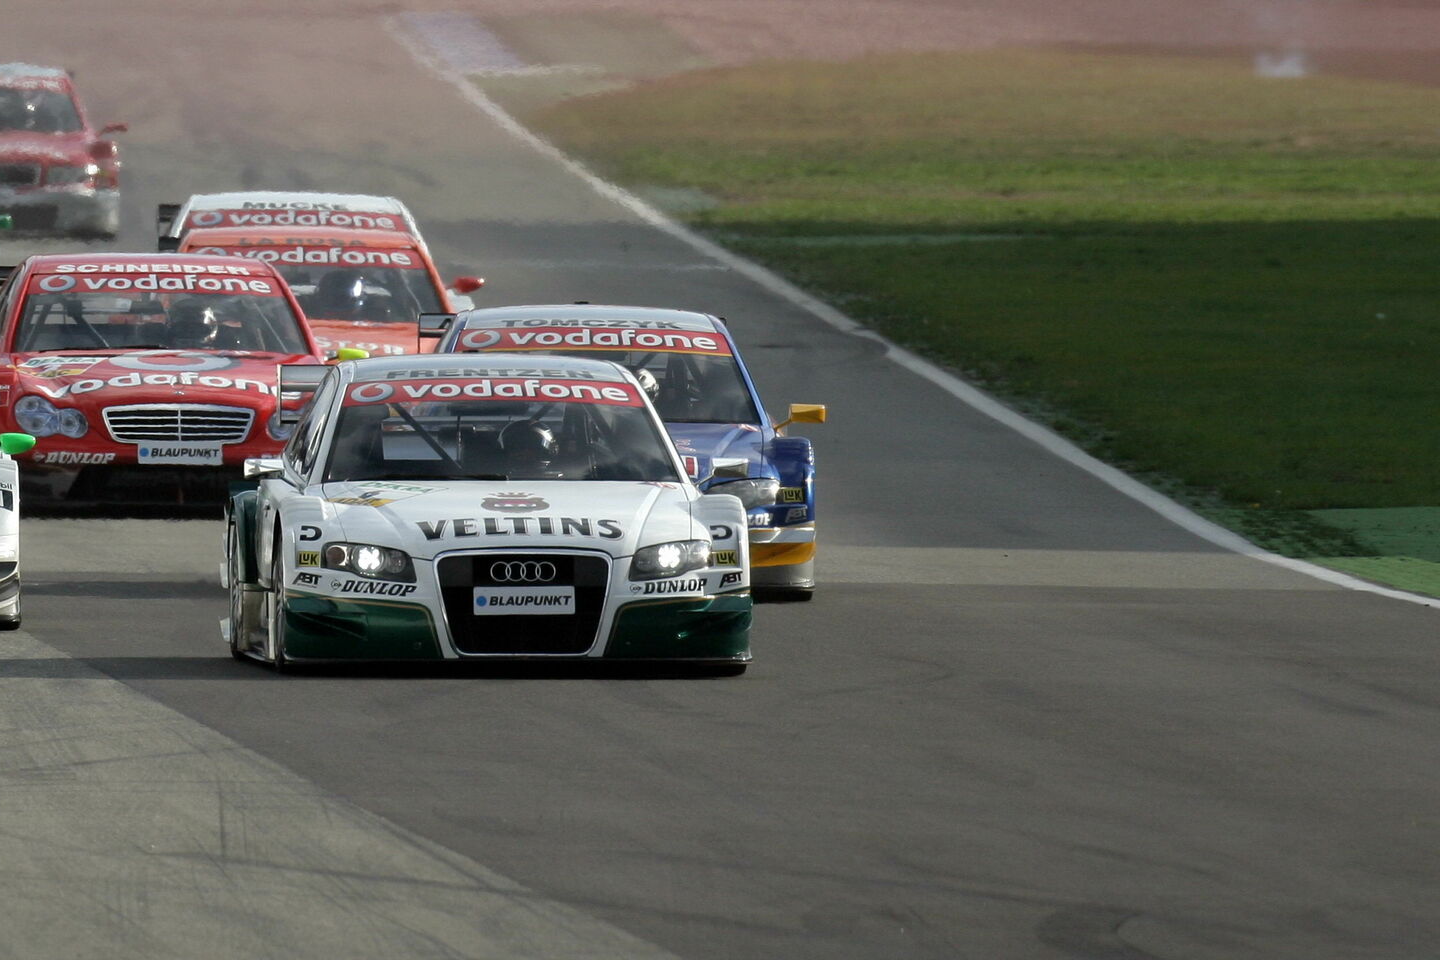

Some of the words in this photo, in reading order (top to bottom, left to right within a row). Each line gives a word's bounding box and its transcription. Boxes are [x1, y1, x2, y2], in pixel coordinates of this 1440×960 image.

[230, 211, 395, 229] vodafone
[56, 264, 250, 275] SCHNEIDER
[83, 275, 271, 293] vodafone
[502, 319, 682, 329] TOMCZYK
[510, 330, 717, 350] vodafone
[387, 369, 595, 380] FRENTZEN
[402, 380, 629, 401] vodafone
[45, 452, 116, 464] DUNLOP
[151, 447, 220, 458] BLAUPUNKT
[747, 513, 773, 526] LOP
[785, 506, 808, 523] ABT
[416, 517, 624, 540] VELTINS
[292, 571, 322, 587] ABT
[643, 578, 707, 594] DUNLOP
[719, 571, 742, 587] ABT
[341, 580, 417, 597] DUNLOP
[489, 595, 572, 606] BLAUPUNKT
